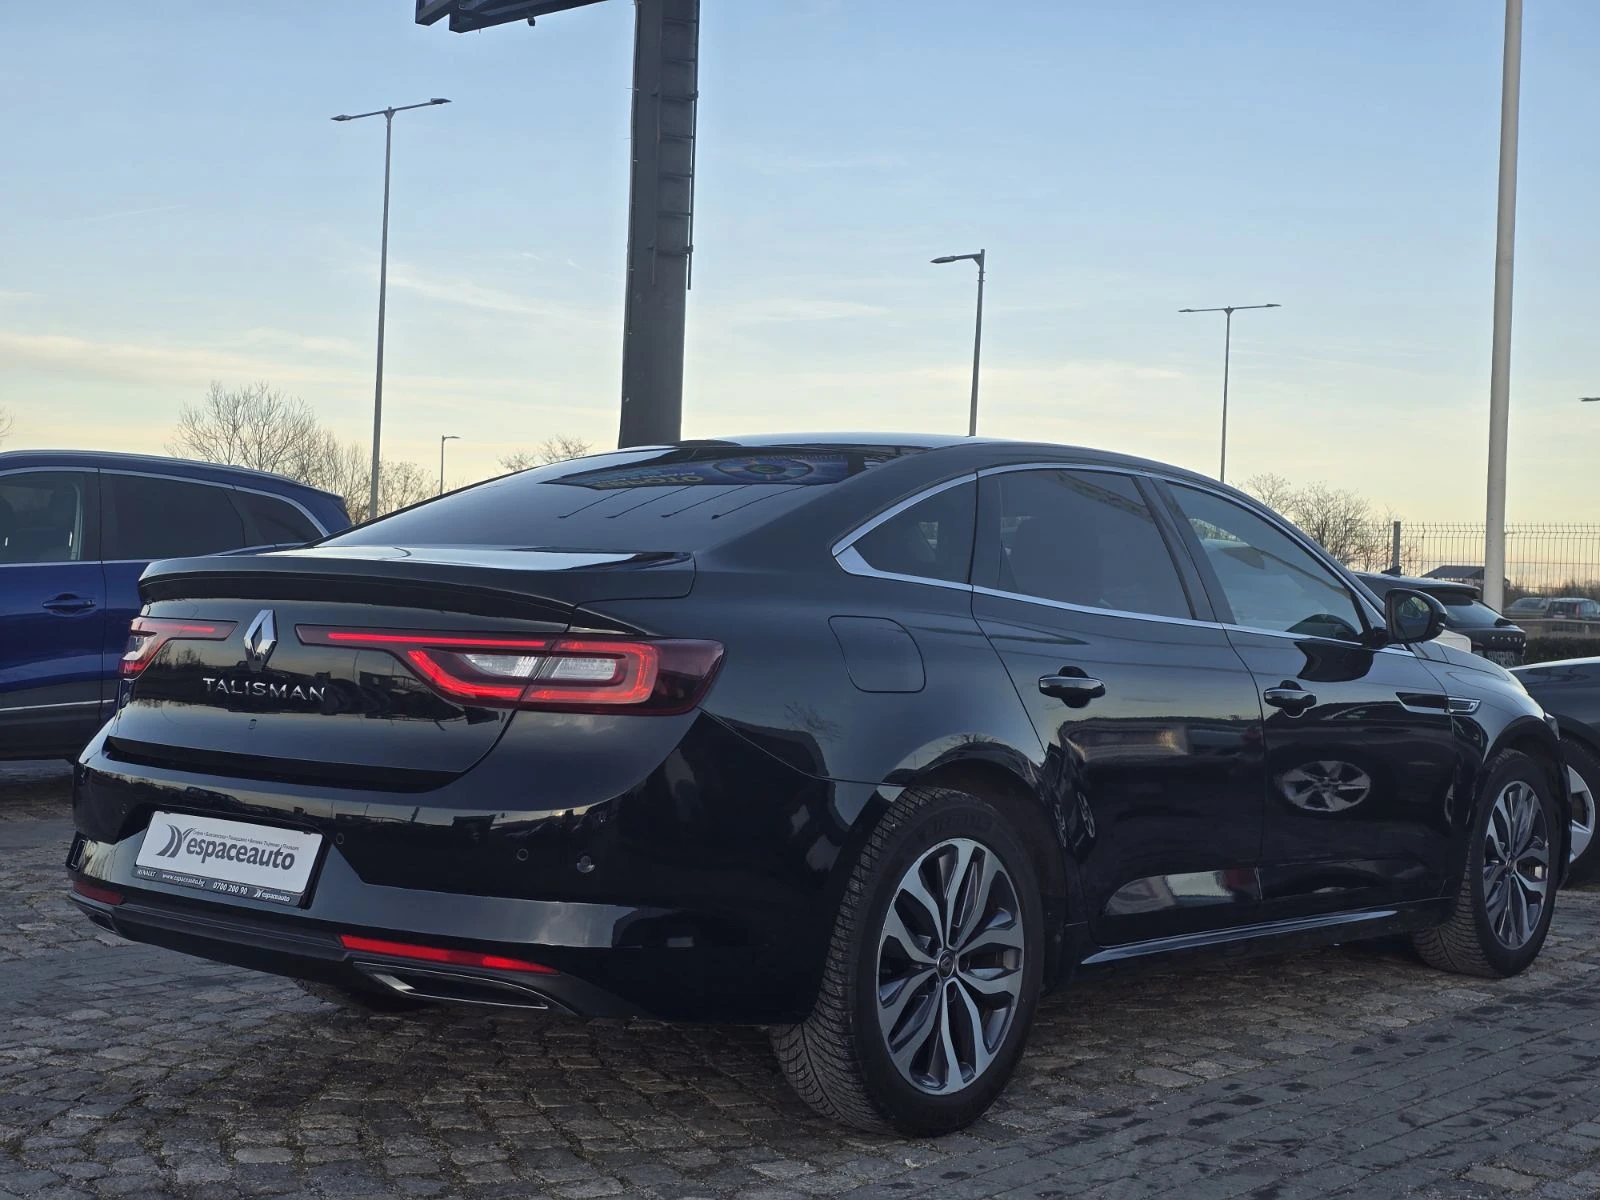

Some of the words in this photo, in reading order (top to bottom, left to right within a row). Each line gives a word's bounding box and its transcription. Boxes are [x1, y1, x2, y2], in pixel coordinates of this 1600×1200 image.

[202, 677, 326, 702] TALISMAN
[186, 836, 296, 871] espaceauto
[212, 881, 227, 891] 0700
[227, 883, 240, 893] 200
[239, 885, 248, 895] 90
[261, 892, 291, 902] espaceauto
